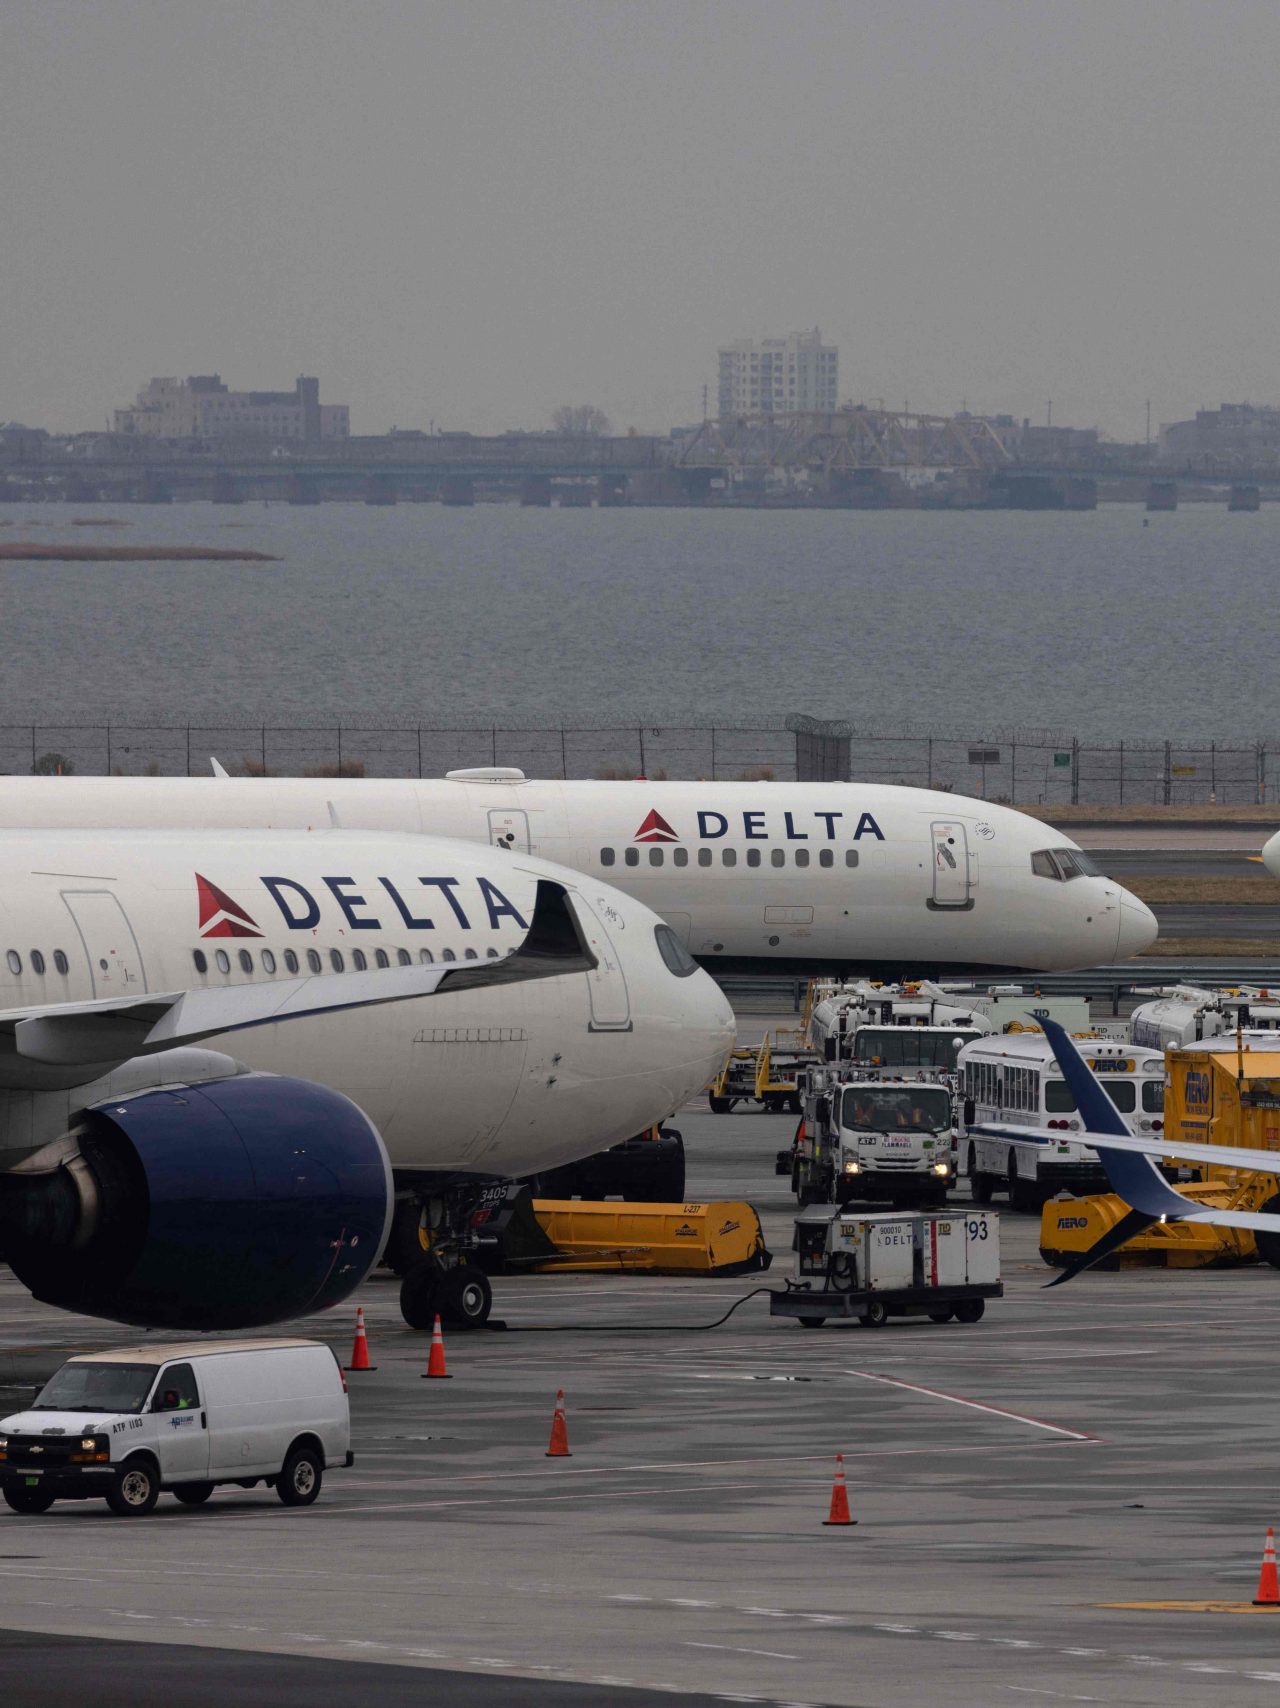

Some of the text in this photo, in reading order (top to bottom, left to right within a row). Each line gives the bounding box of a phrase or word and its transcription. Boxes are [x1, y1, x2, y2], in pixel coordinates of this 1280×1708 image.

[696, 811, 886, 841] DELTA
[259, 876, 530, 930] DELTA
[1092, 1059, 1128, 1072] AERO
[1185, 1072, 1209, 1104] AERO
[480, 1185, 507, 1202] 3405
[968, 1220, 989, 1241] 93
[1057, 1217, 1088, 1229] AERO
[885, 1234, 920, 1246] DELTA
[112, 1422, 126, 1434] ATP
